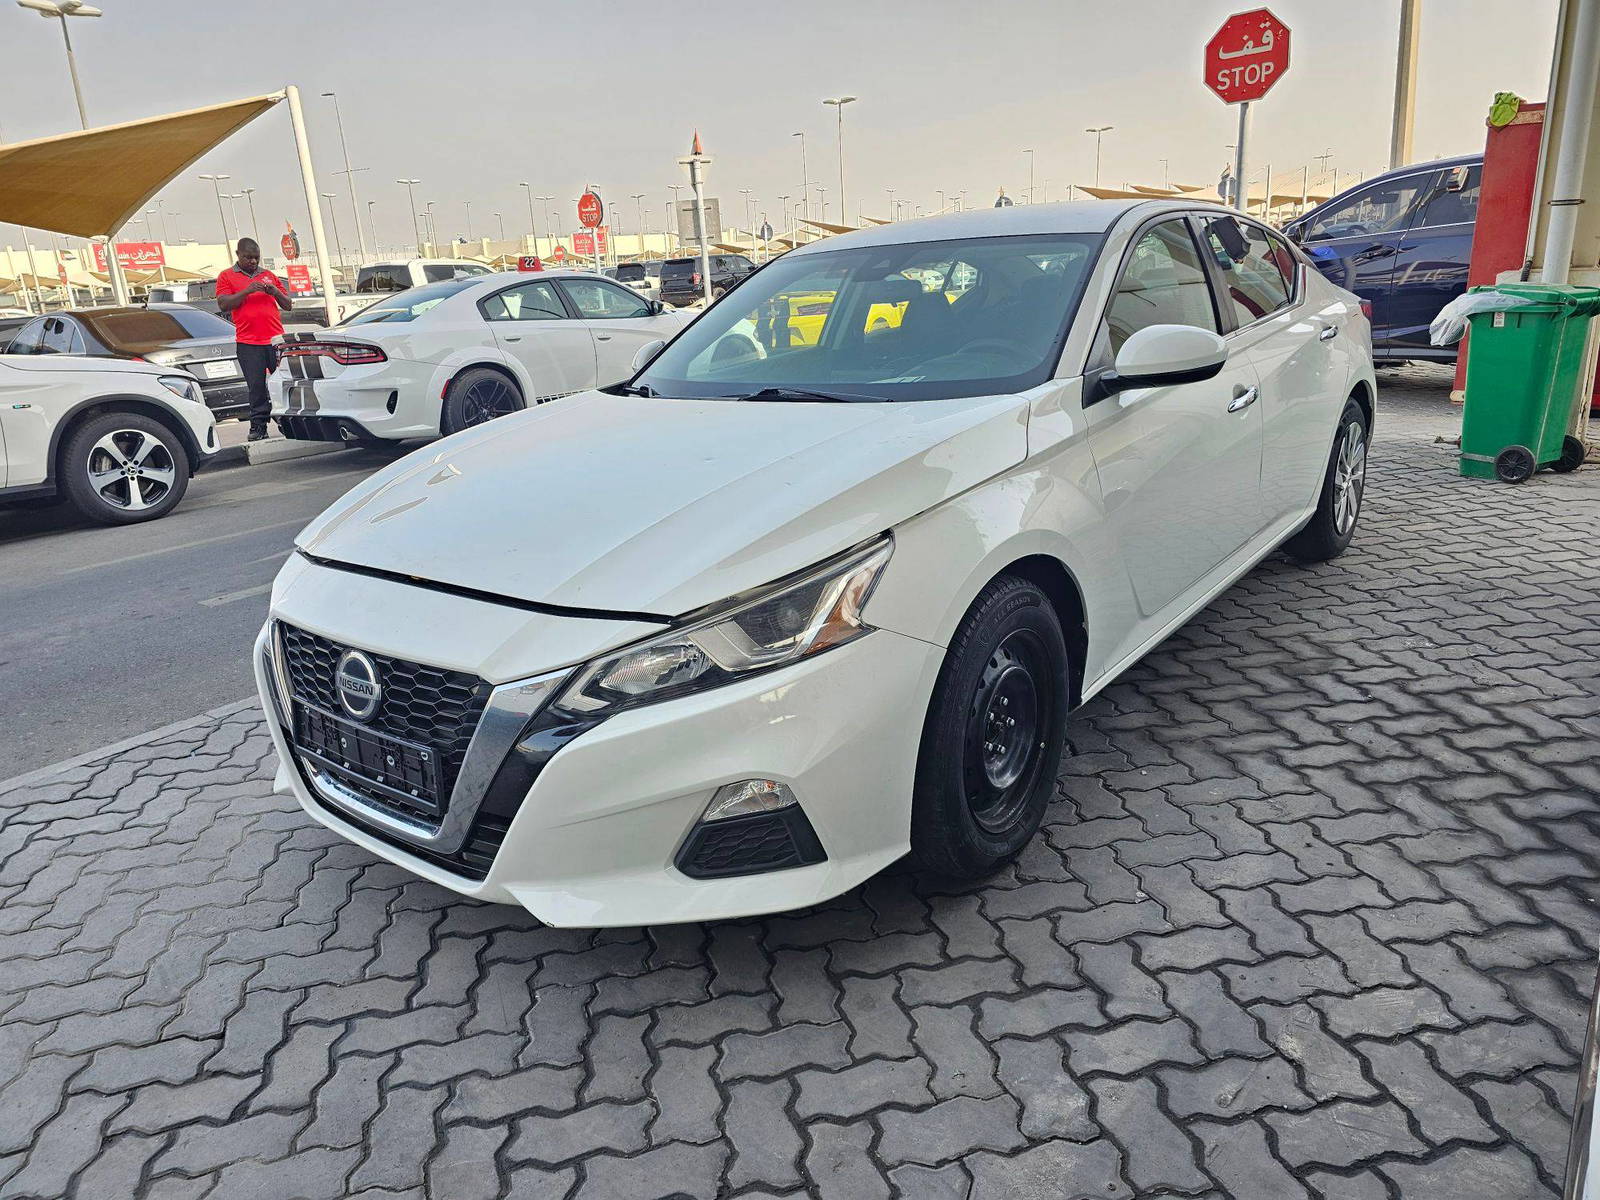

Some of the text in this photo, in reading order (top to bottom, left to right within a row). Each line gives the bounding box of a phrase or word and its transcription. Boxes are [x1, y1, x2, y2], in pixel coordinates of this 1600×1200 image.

[1218, 21, 1274, 60] قف
[1216, 61, 1275, 91] STOP
[582, 213, 598, 223] STOP
[524, 257, 535, 268] 22
[339, 676, 374, 696] NISSAN
